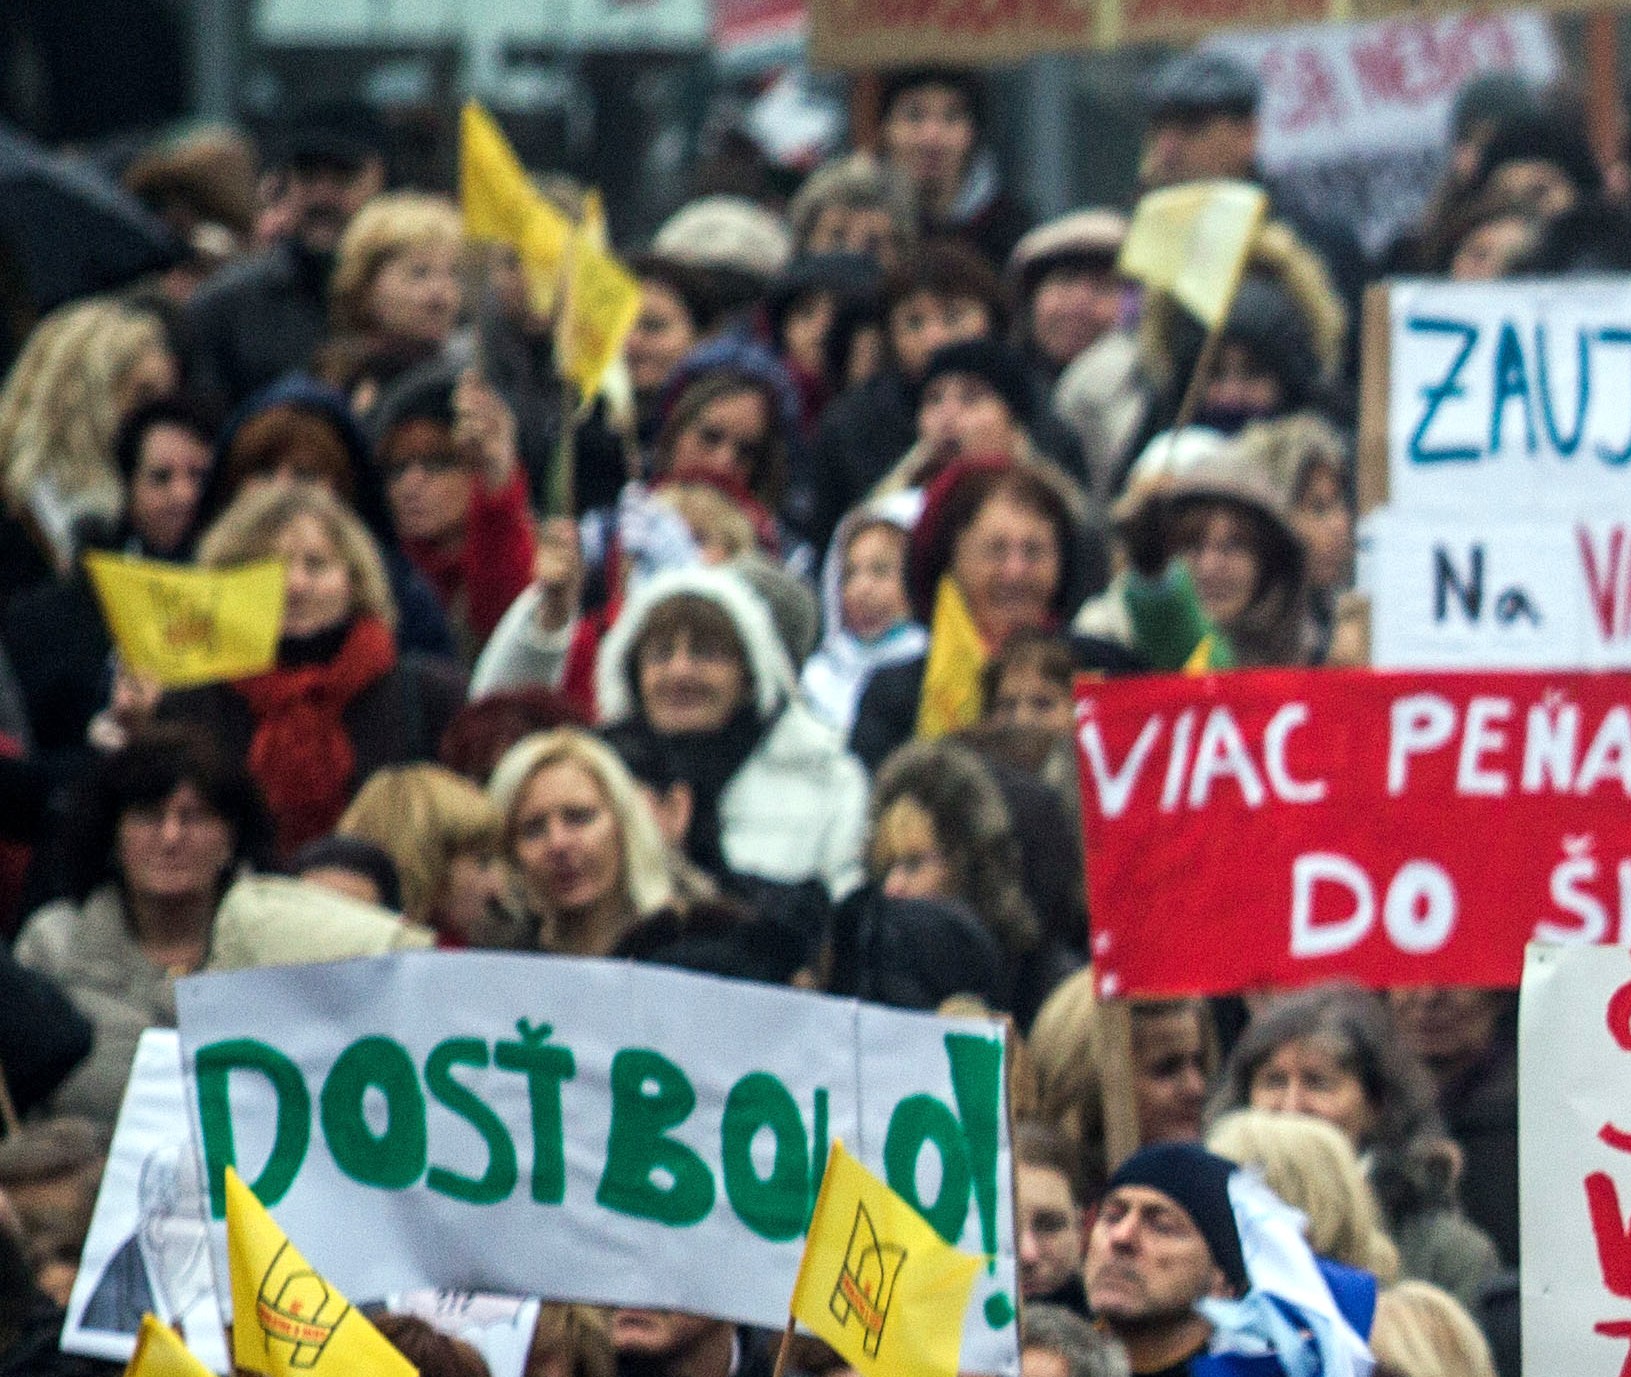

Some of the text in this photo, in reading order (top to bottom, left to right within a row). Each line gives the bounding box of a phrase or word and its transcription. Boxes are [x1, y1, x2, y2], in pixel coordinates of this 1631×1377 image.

[1430, 538, 1544, 632] Na
[1078, 700, 1326, 819] VIAC
[1289, 851, 1458, 958] DO
